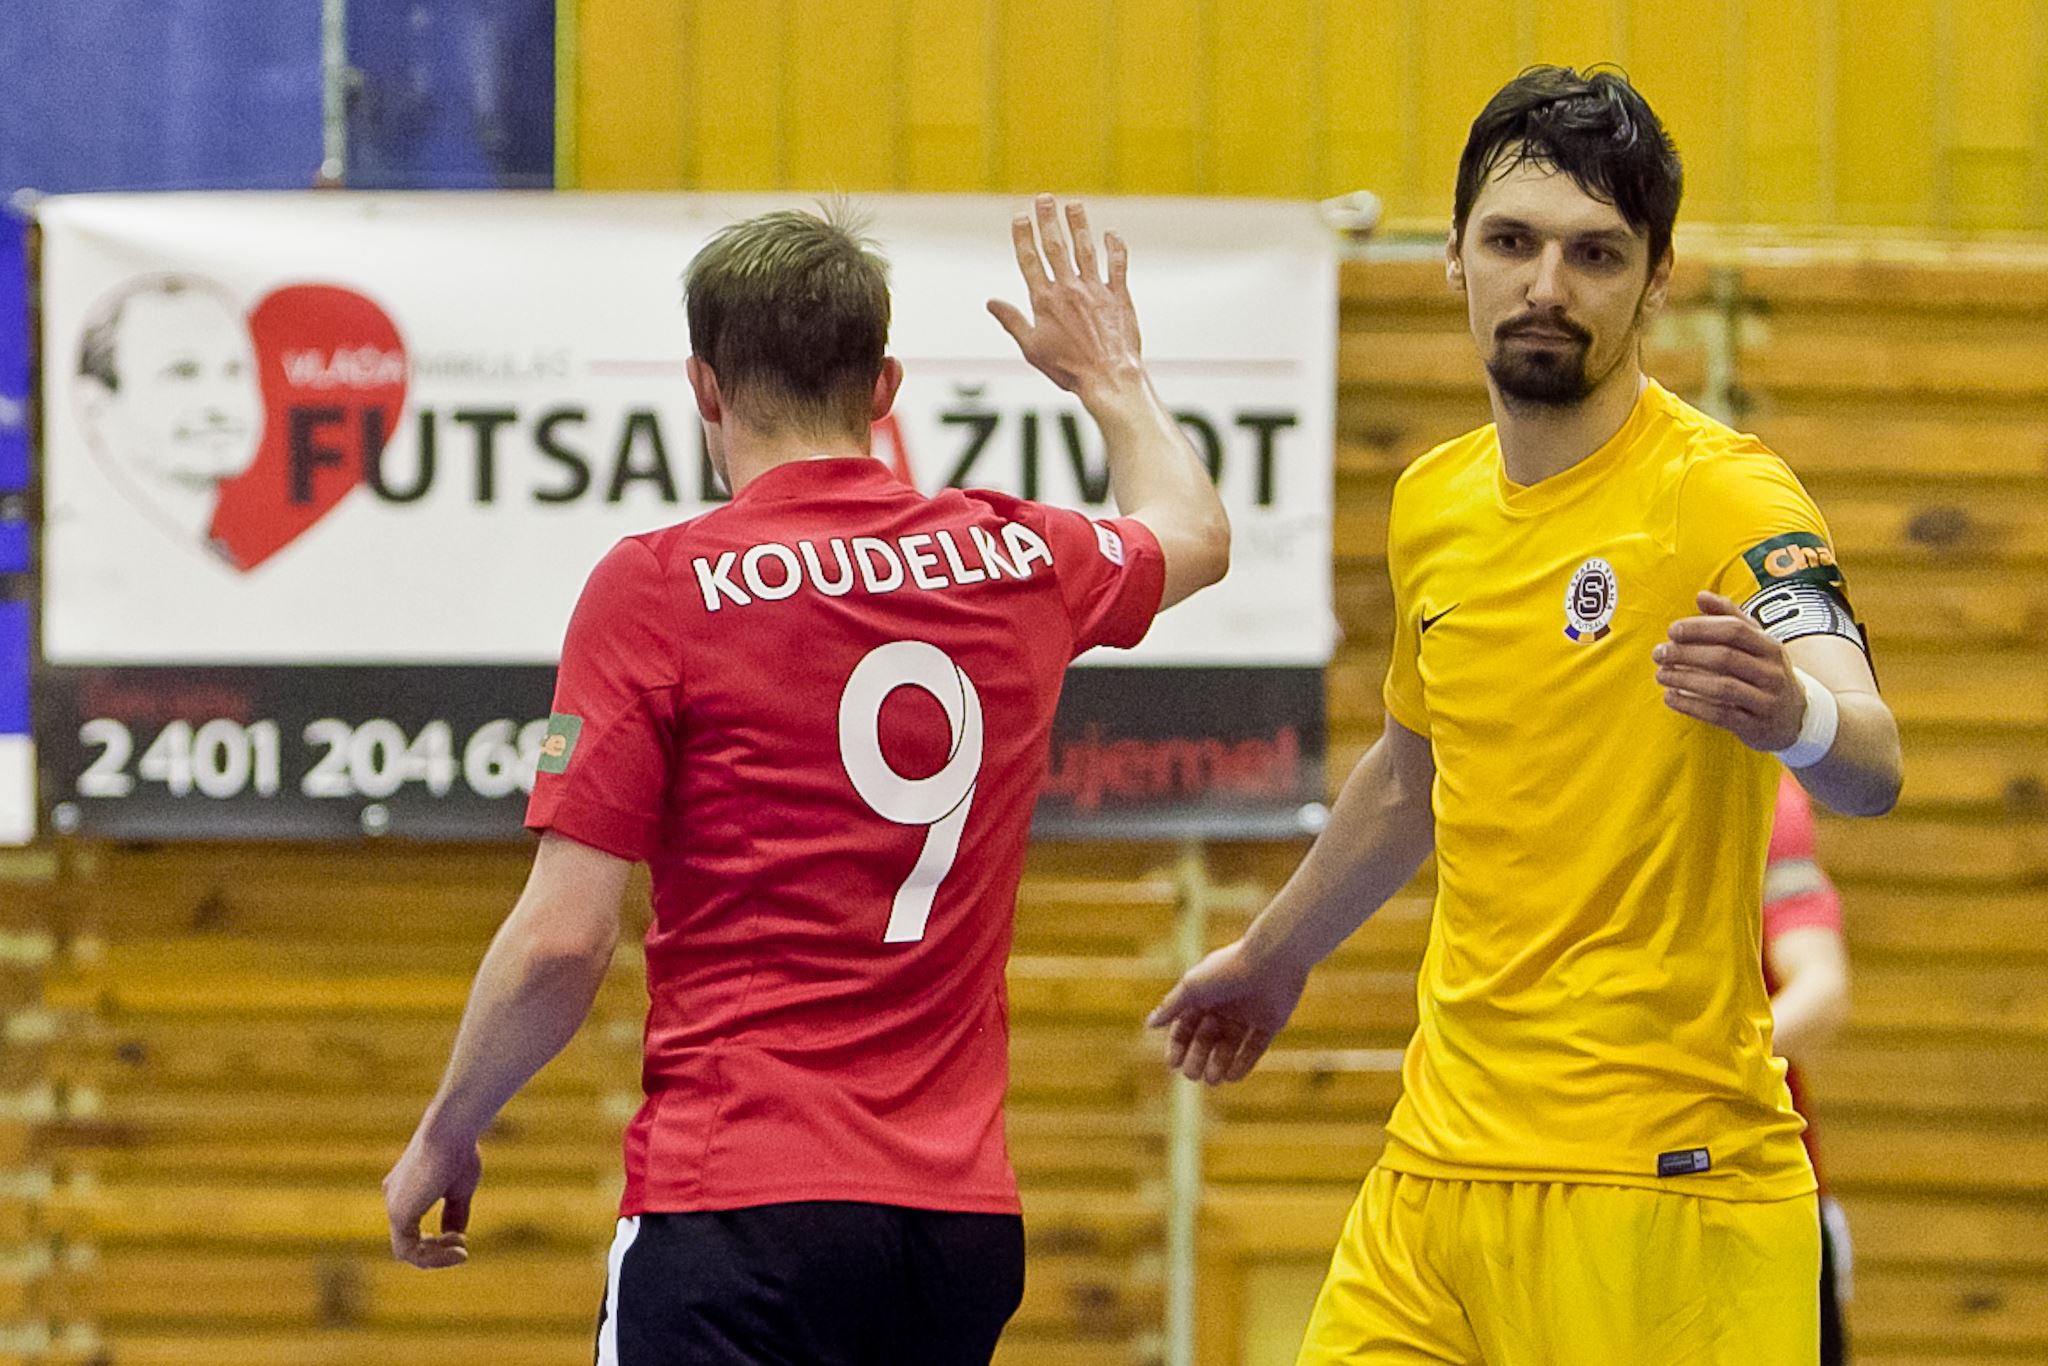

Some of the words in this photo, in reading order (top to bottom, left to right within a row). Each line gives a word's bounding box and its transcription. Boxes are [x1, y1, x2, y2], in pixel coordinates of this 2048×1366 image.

[692, 520, 1055, 612] KOUDELKA
[302, 717, 458, 799] 204
[838, 640, 985, 943] 9
